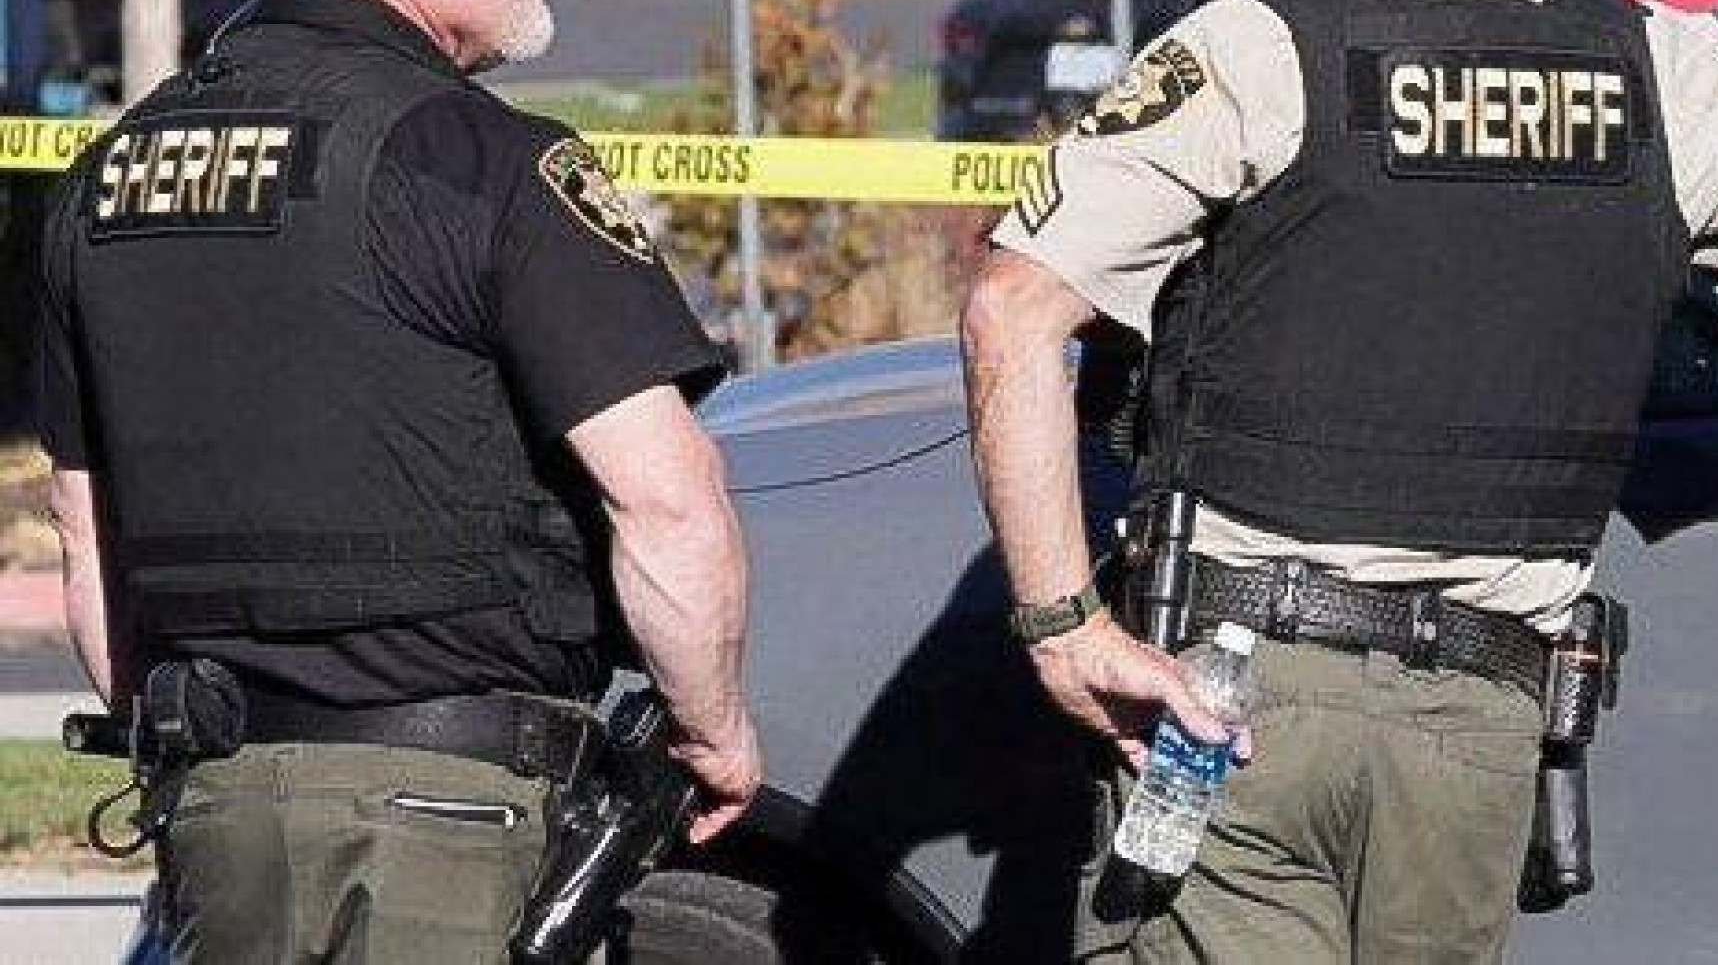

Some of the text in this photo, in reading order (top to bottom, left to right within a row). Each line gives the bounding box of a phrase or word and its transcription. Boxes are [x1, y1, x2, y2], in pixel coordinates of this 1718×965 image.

[1391, 65, 1624, 162] SHERIFF
[99, 129, 291, 217] SHERIFF
[598, 141, 752, 183] OT CROSS
